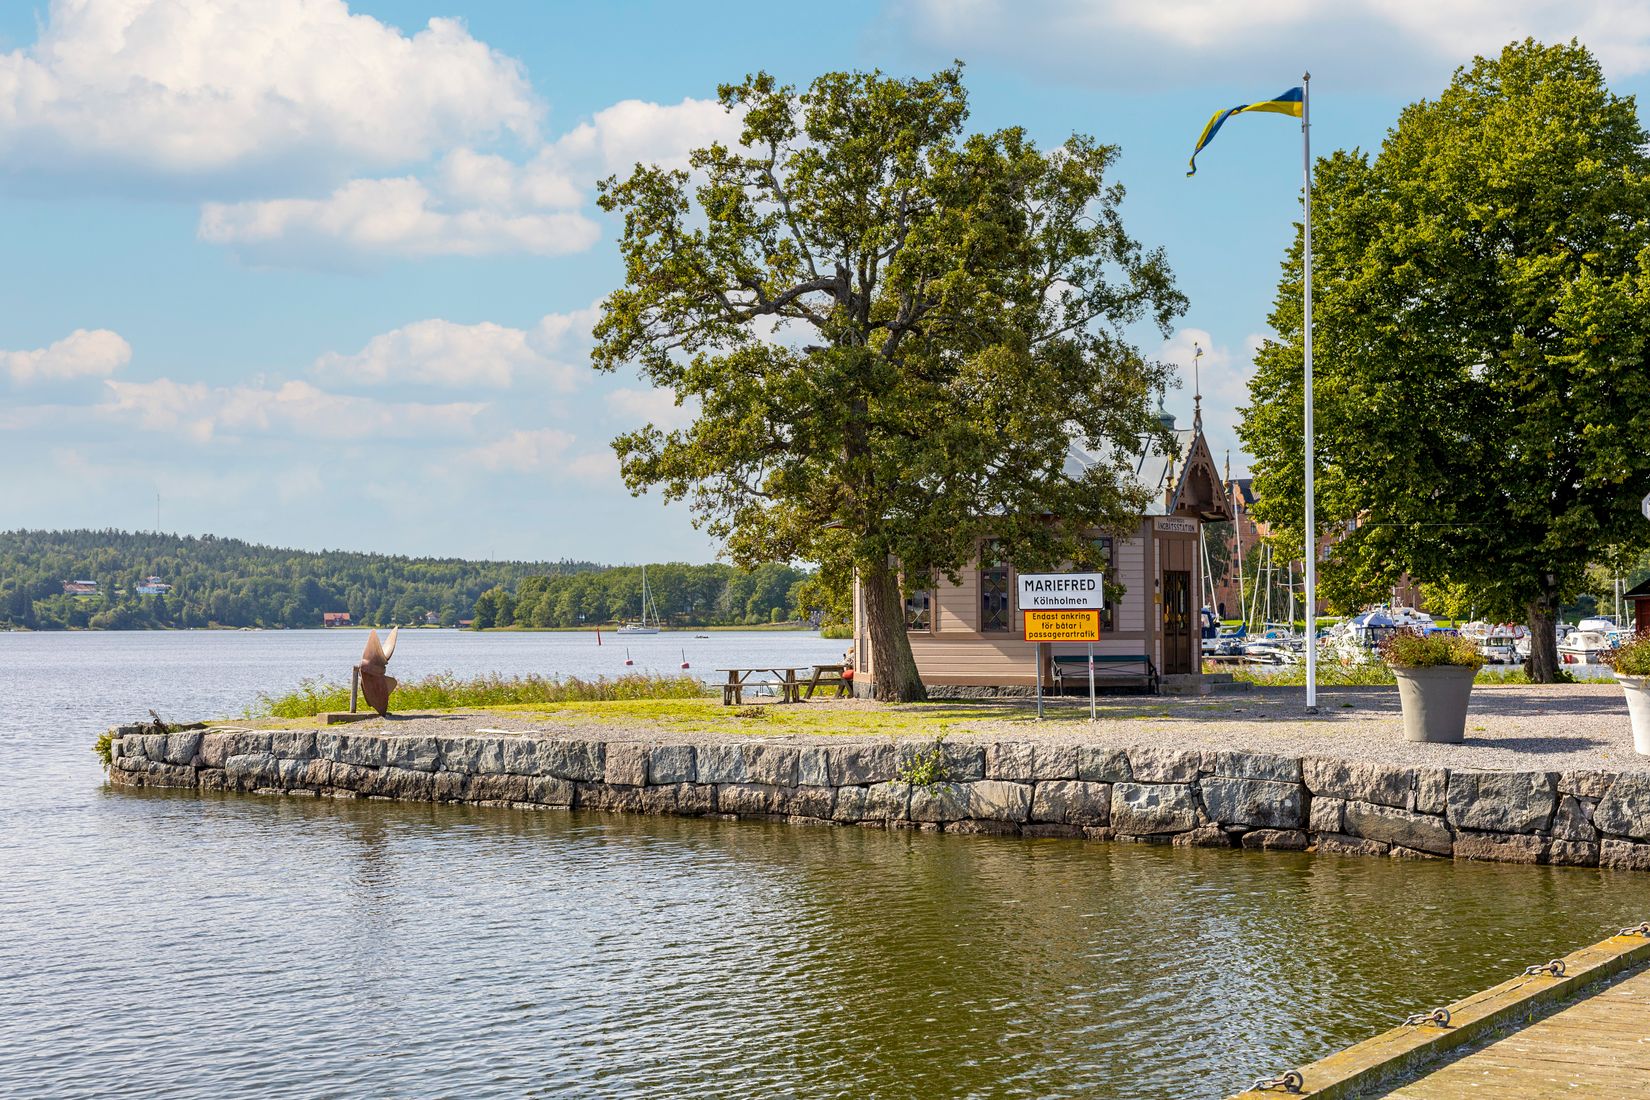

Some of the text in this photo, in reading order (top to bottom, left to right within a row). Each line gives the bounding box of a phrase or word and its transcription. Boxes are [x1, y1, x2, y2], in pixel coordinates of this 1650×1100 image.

[1025, 579, 1096, 592] MARIEFRED
[1033, 596, 1088, 605] Kölnholmen
[1060, 613, 1091, 621] ankring
[1041, 622, 1053, 630] för
[1055, 622, 1077, 630] båtar
[1028, 630, 1096, 639] passagerartrafik
